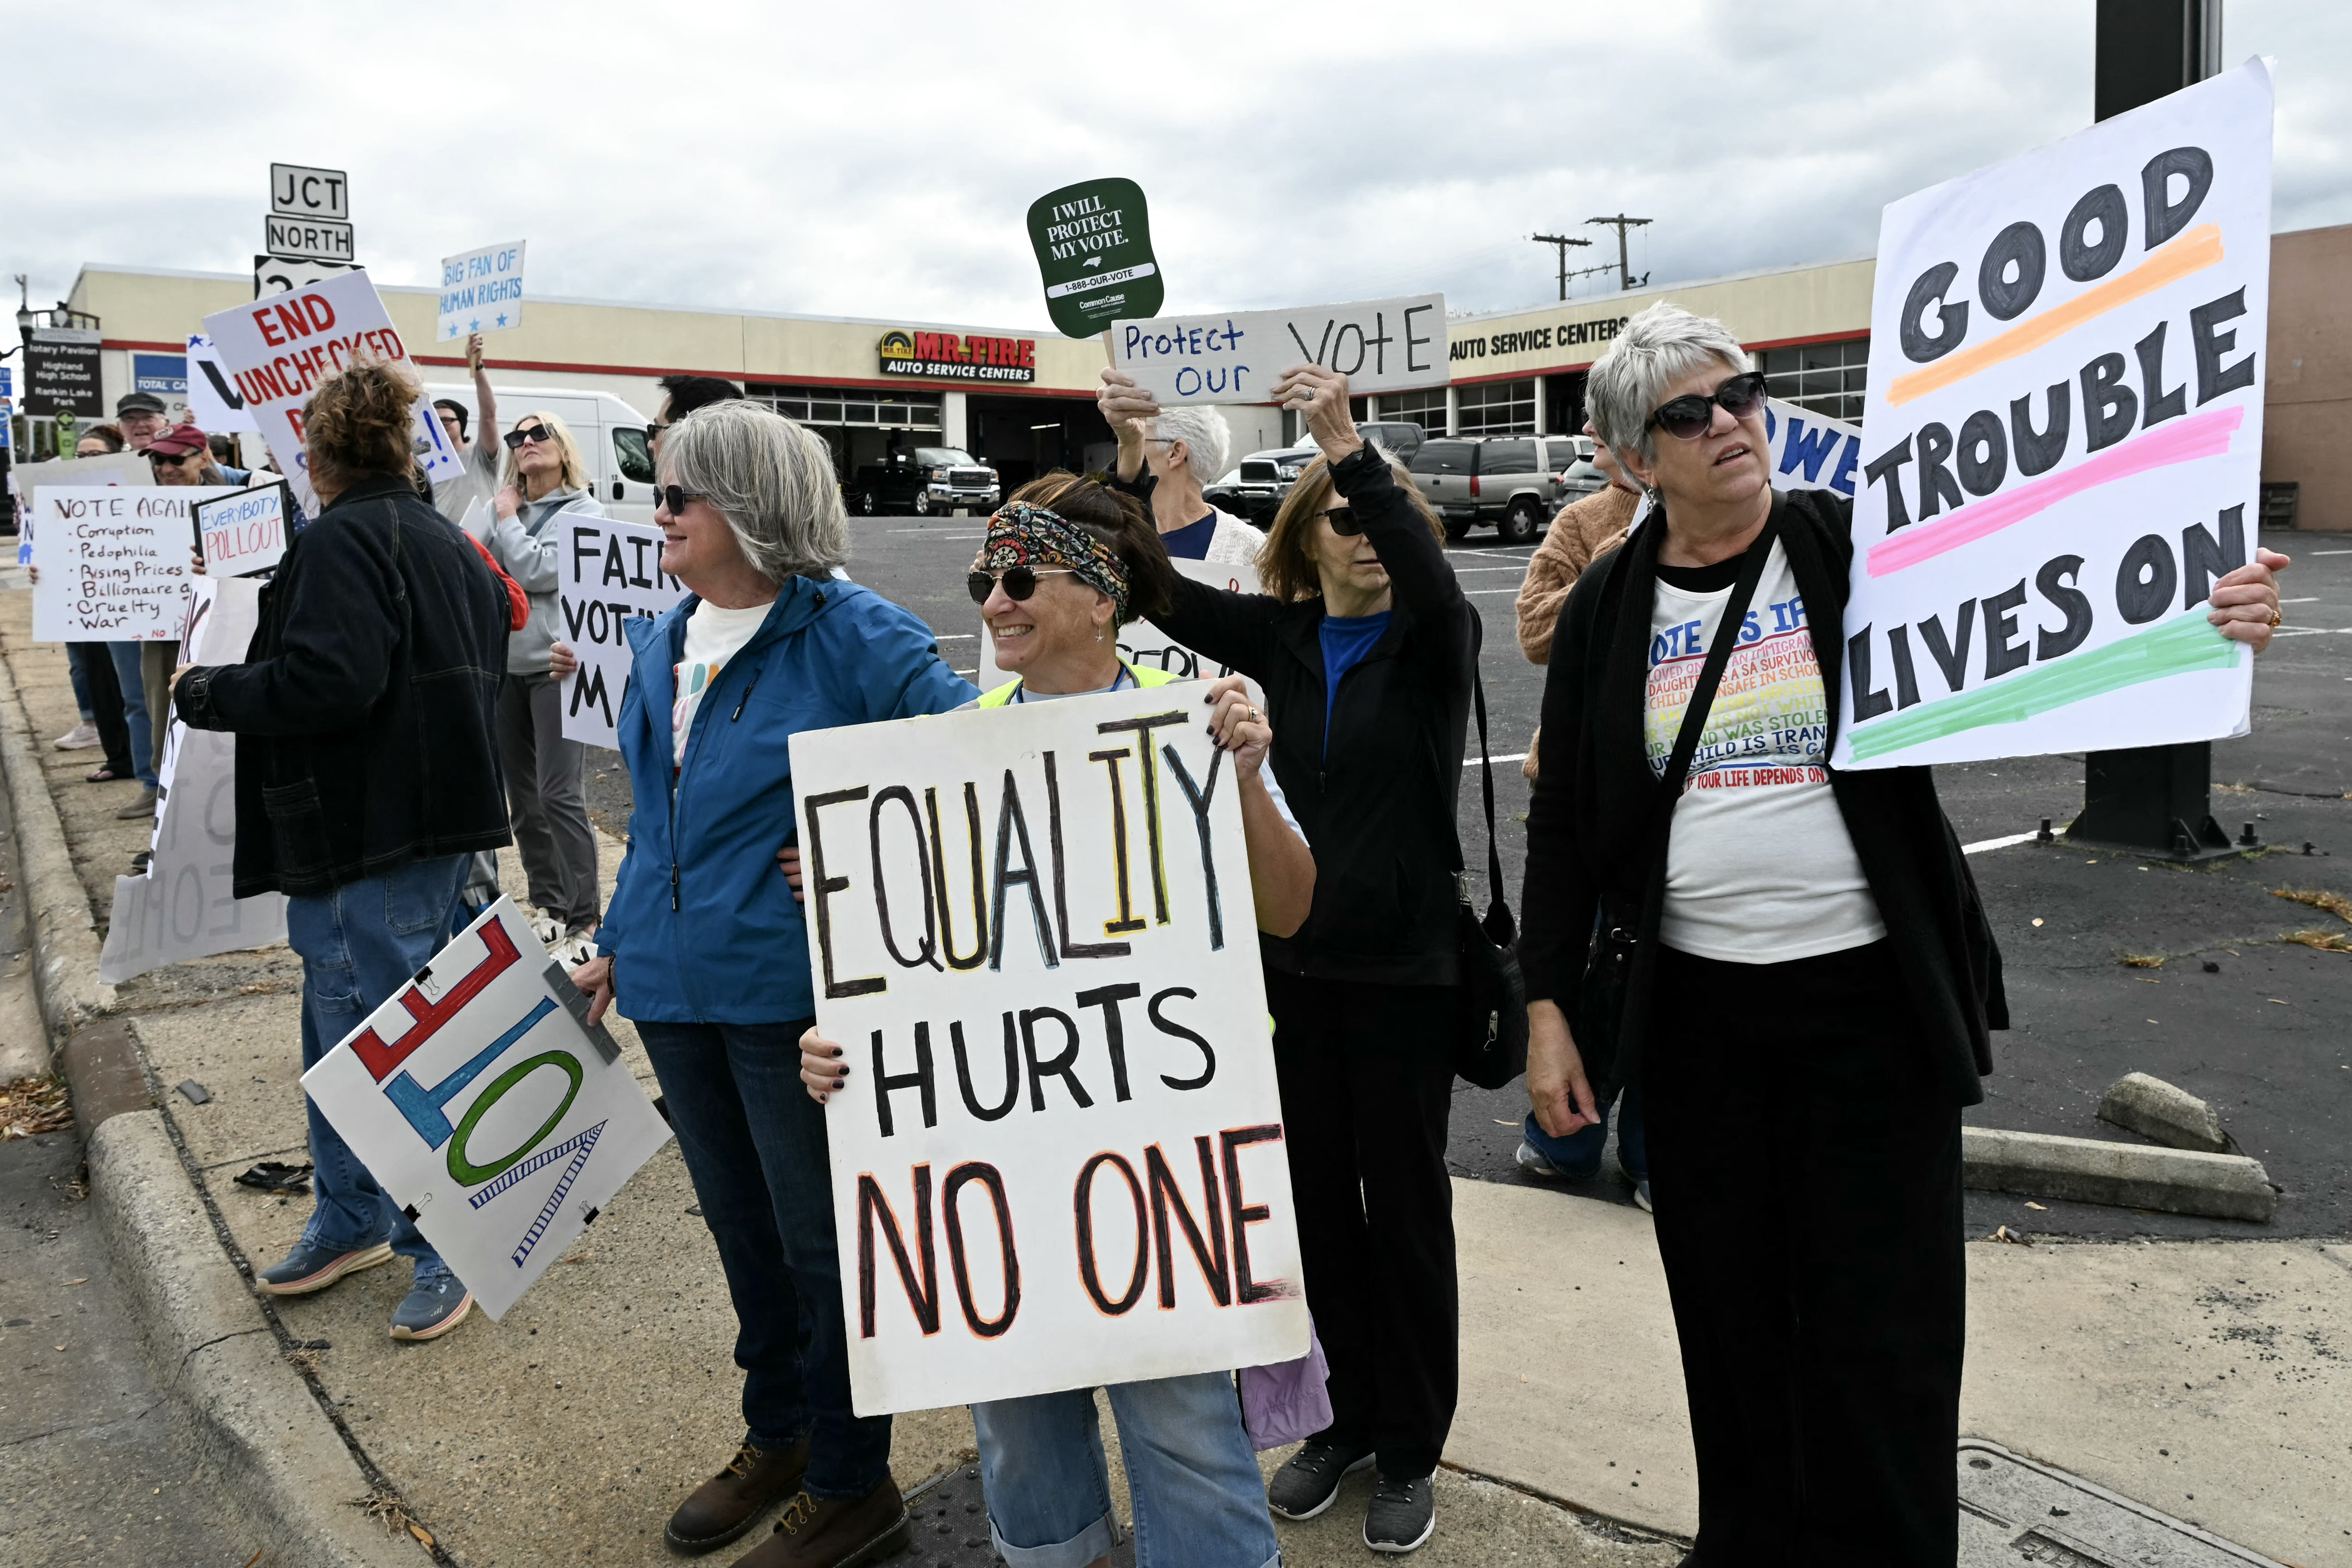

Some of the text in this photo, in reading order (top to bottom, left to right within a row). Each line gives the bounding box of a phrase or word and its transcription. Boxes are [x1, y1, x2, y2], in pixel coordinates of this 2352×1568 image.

[278, 174, 342, 211] JCT
[1053, 195, 1105, 222] I WILL
[270, 224, 350, 253] NORTH
[1047, 209, 1122, 242] PROTECT
[1051, 229, 1129, 261] MY VOTE.
[1900, 146, 2214, 363] GOOD
[444, 249, 516, 287] BIG FAN OF
[1065, 269, 1134, 292] 1-888-OUR-VOTE
[439, 277, 522, 315] HUMAN RIGHTS
[1080, 293, 1125, 309] Common Cause
[252, 293, 336, 347] END
[914, 332, 1035, 367] MR. TIRE
[1450, 338, 1486, 361] AUTO
[1491, 328, 1551, 356] SERVICE
[36, 371, 91, 381] High School
[42, 361, 84, 372] Highland
[887, 361, 1030, 380] AUTO SERVICE CENTERS
[70, 388, 93, 397] Lake
[137, 380, 168, 390] TOTAL
[53, 397, 76, 406] Park
[1864, 285, 2255, 534] TROUBLE
[54, 499, 124, 519] VOTE
[77, 524, 154, 540] Corruption
[81, 543, 157, 560] Pedophilia
[81, 561, 183, 583] Rising Prices
[82, 581, 172, 598] Billionaire
[77, 600, 160, 620] Cruelty
[80, 614, 129, 630] War
[1848, 502, 2247, 723] LIVES ON
[151, 630, 166, 638] NO
[1650, 620, 1702, 666] OTE
[1769, 596, 1810, 633] IF
[1647, 635, 1813, 683] LOVED ON AN IMMIGRAN
[1731, 668, 1739, 681] A
[1741, 661, 1758, 676] SA
[1760, 650, 1816, 671] SURVIVO
[1650, 692, 1687, 710] CHILD
[1759, 671, 1776, 686] IN
[1779, 663, 1822, 681] SCHOO
[1711, 692, 1755, 716] FFORD
[1760, 679, 1824, 703] HOUSIN
[1714, 714, 1732, 729] IS
[1737, 703, 1770, 724] NOT
[1777, 694, 1824, 713] WHIT
[1647, 743, 1666, 762] UR
[1723, 721, 1764, 741] WAS
[1693, 742, 1736, 763] HILD
[1743, 736, 1766, 751] IS
[1772, 725, 1826, 745] TRAN
[1776, 744, 1801, 754] IS
[1698, 771, 1722, 789] YOUR
[1725, 770, 1750, 787] LIFE
[1753, 767, 1804, 786] DEPENDS
[1808, 767, 1825, 783] ON
[804, 710, 1225, 999] EQUALITY
[871, 983, 1216, 1137] HURTS
[348, 914, 609, 1269] VOTE
[857, 1124, 1302, 1340] NO ONE
